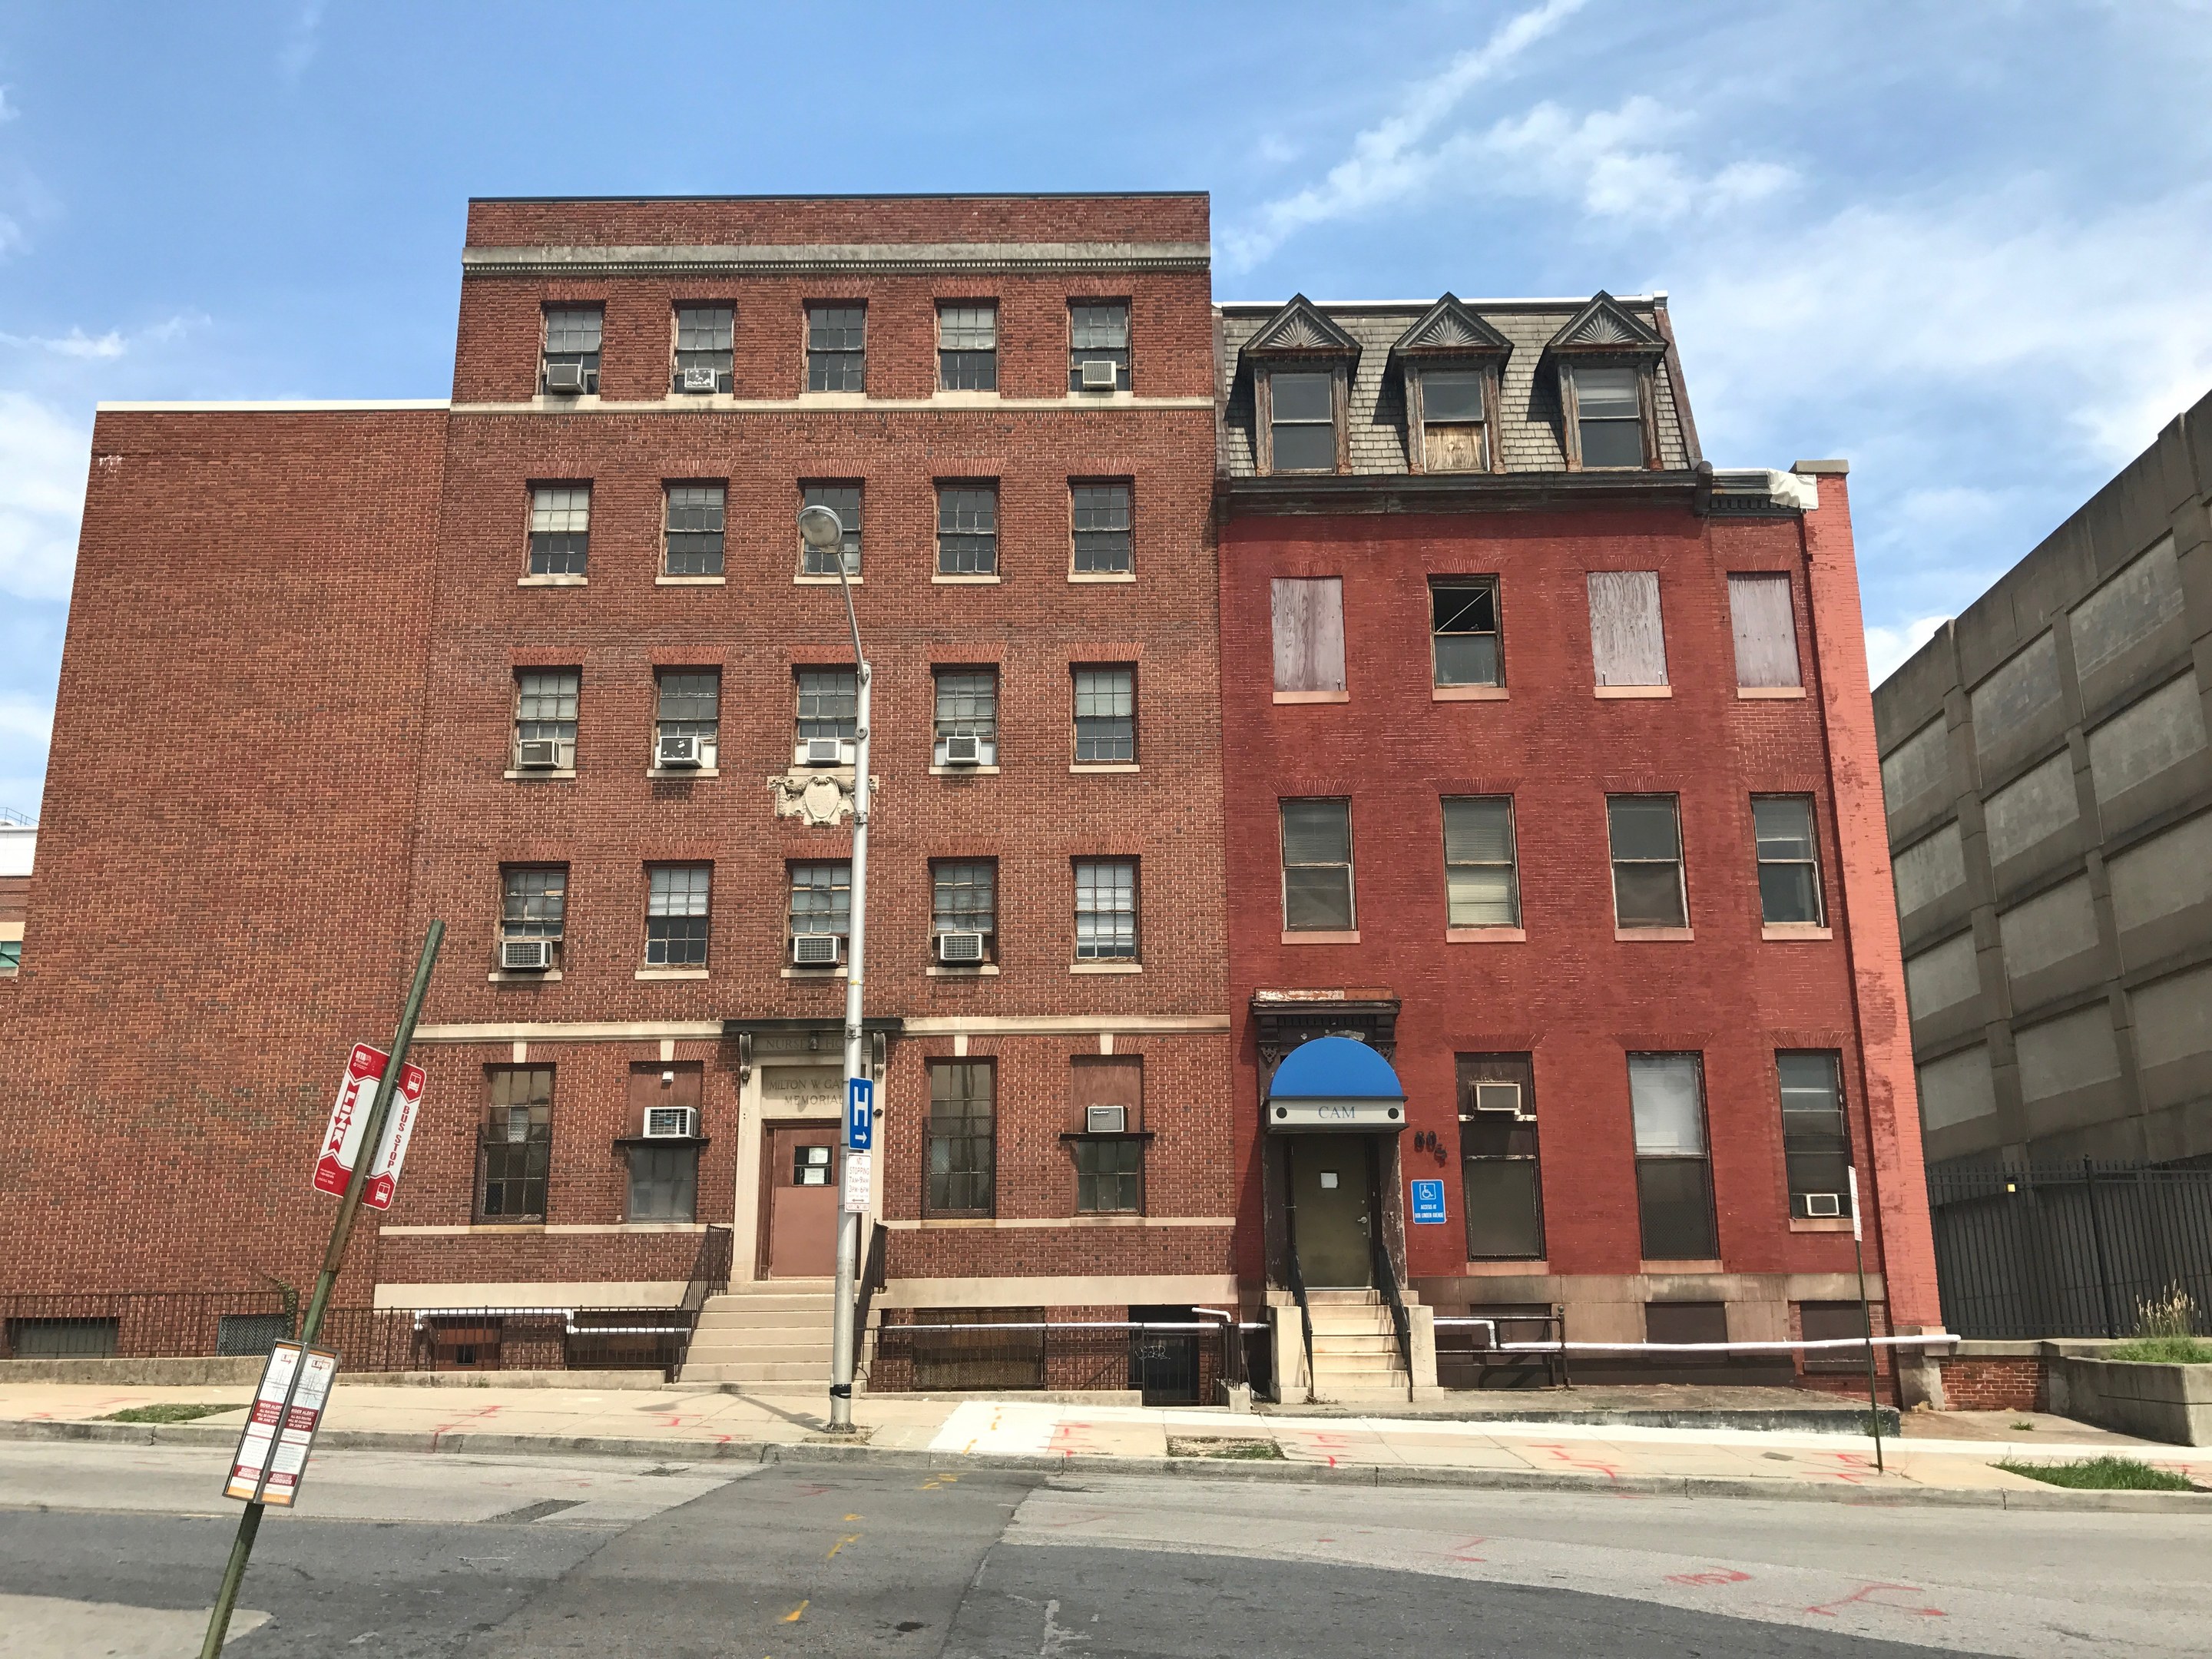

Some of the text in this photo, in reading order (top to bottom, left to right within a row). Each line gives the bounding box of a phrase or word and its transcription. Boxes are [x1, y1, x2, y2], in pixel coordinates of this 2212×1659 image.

[769, 1079, 806, 1091] MILTON
[784, 1095, 843, 1106] MEMORIAL
[853, 1086, 869, 1128] H
[329, 1085, 358, 1149] LINK
[1318, 1106, 1356, 1119] CAM
[387, 1105, 410, 1168] BUS STOP
[849, 1167, 869, 1175] STOPPING
